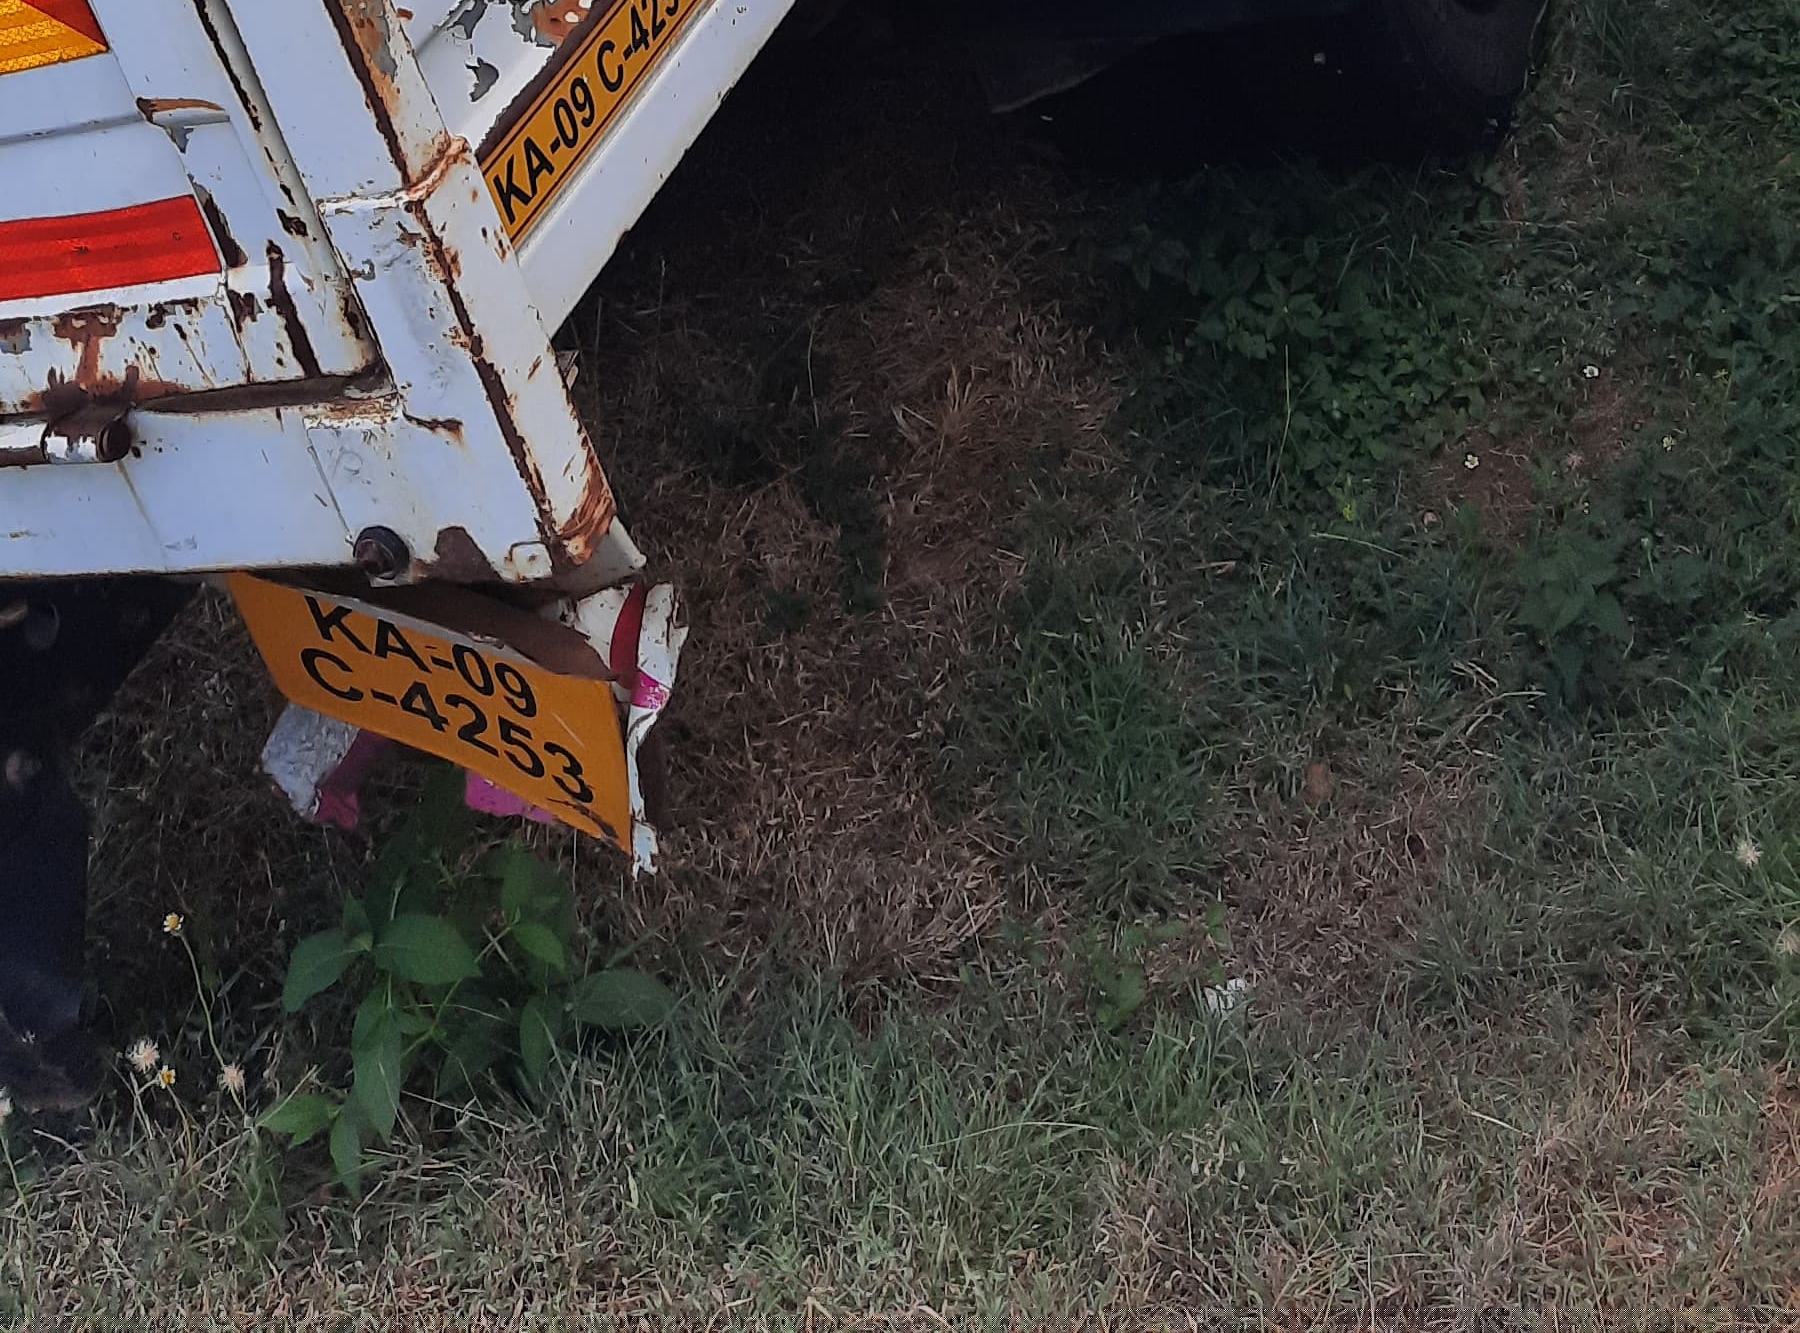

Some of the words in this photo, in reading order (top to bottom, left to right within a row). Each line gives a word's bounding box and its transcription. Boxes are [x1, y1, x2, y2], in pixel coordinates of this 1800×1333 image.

[494, 77, 595, 224] KA-09
[300, 648, 593, 803] C-4253
[305, 596, 536, 717] KA-09
